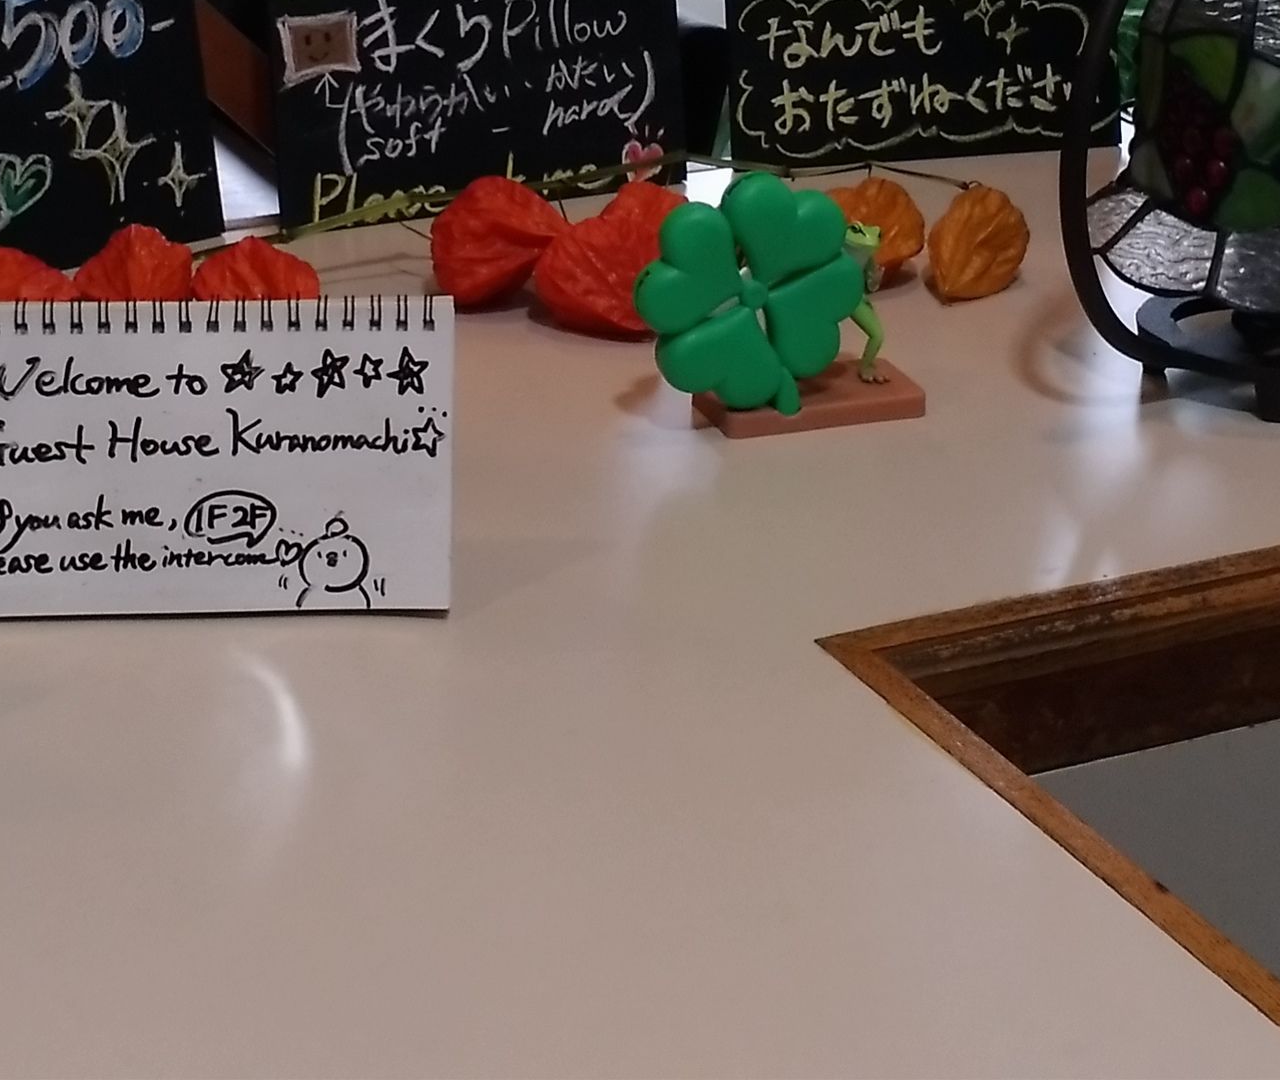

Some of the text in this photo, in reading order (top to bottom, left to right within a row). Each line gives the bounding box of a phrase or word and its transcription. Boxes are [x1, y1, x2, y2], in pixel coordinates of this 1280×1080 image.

[756, 5, 943, 69] なんでも
[357, 84, 634, 166] soft hard
[166, 364, 208, 396] to
[108, 417, 220, 462] House
[226, 408, 409, 457] Kuranomachi
[0, 514, 61, 554] you
[68, 494, 114, 530] ask
[60, 554, 108, 575] use
[110, 538, 157, 573] the
[162, 545, 277, 568] intercom
